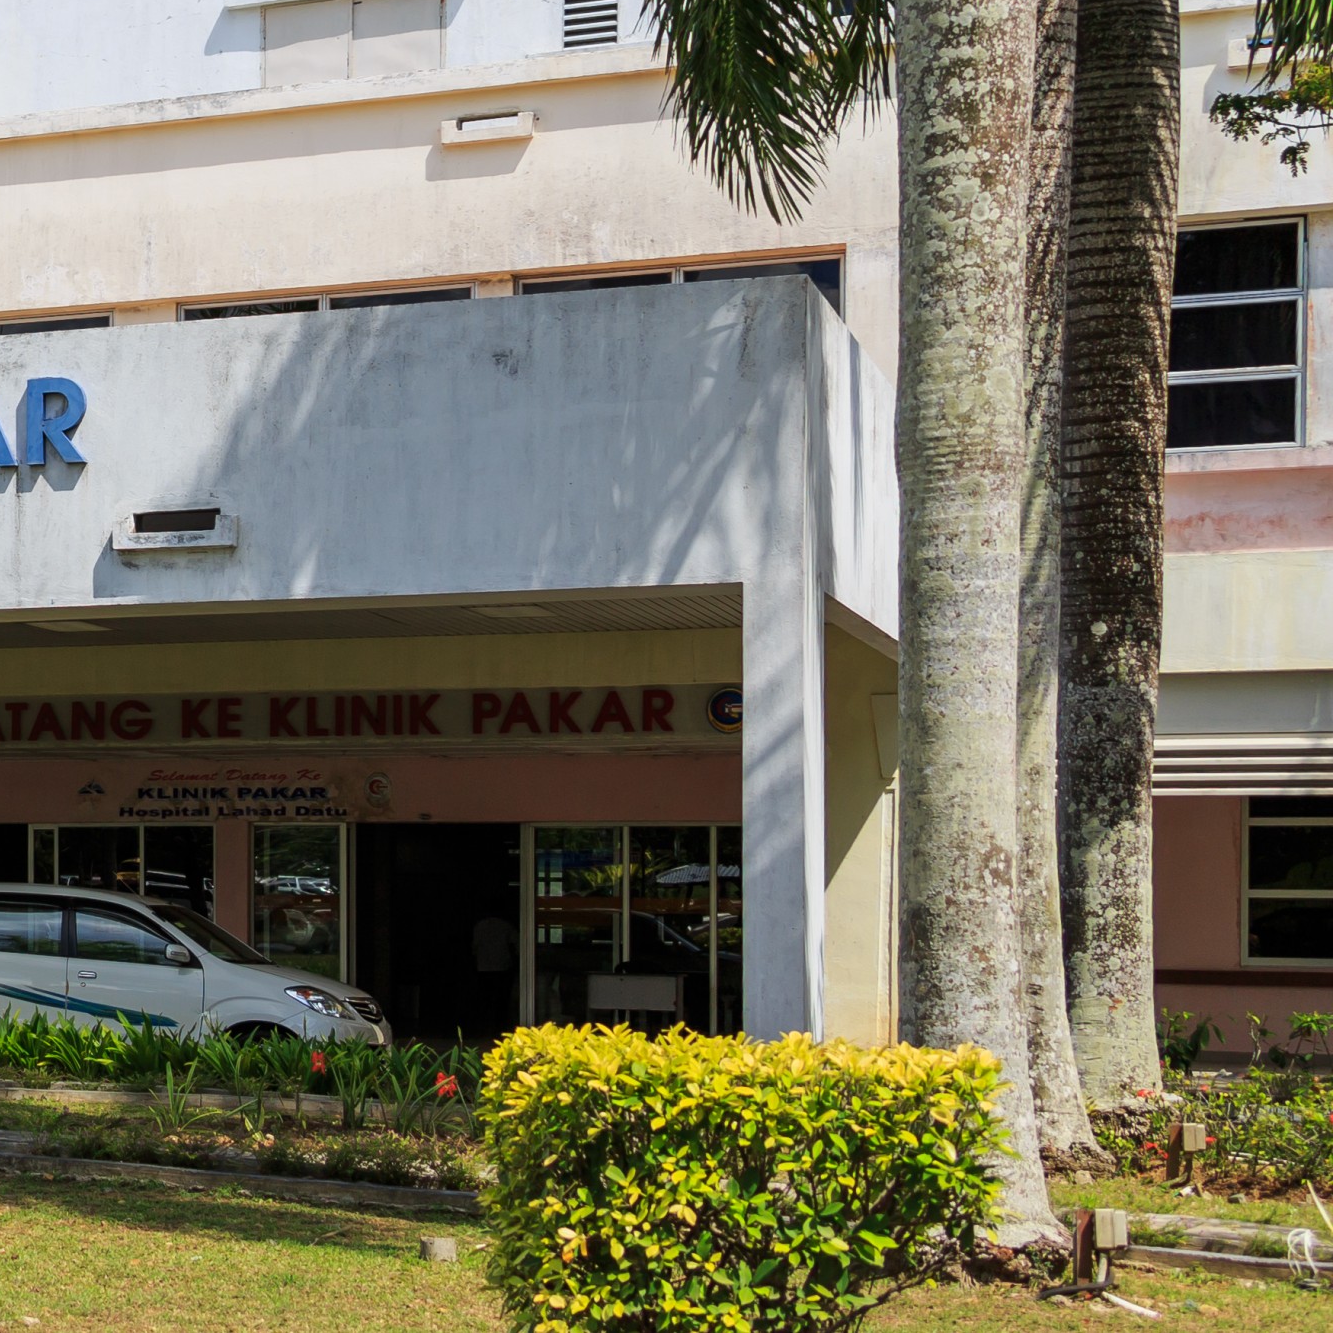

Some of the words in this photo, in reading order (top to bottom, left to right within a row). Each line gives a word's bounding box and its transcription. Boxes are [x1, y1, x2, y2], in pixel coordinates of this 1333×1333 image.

[181, 698, 242, 738] KE
[270, 694, 441, 737] KLINIK
[472, 689, 675, 734] PAKAR
[147, 769, 218, 781] Selamat
[226, 769, 287, 784] Datang
[296, 769, 322, 780] Ke
[138, 787, 228, 798] KLINIK
[237, 787, 327, 798] PAKAR
[119, 806, 209, 819] Hospital
[218, 806, 286, 817] Lahad
[295, 806, 347, 817] Datu
